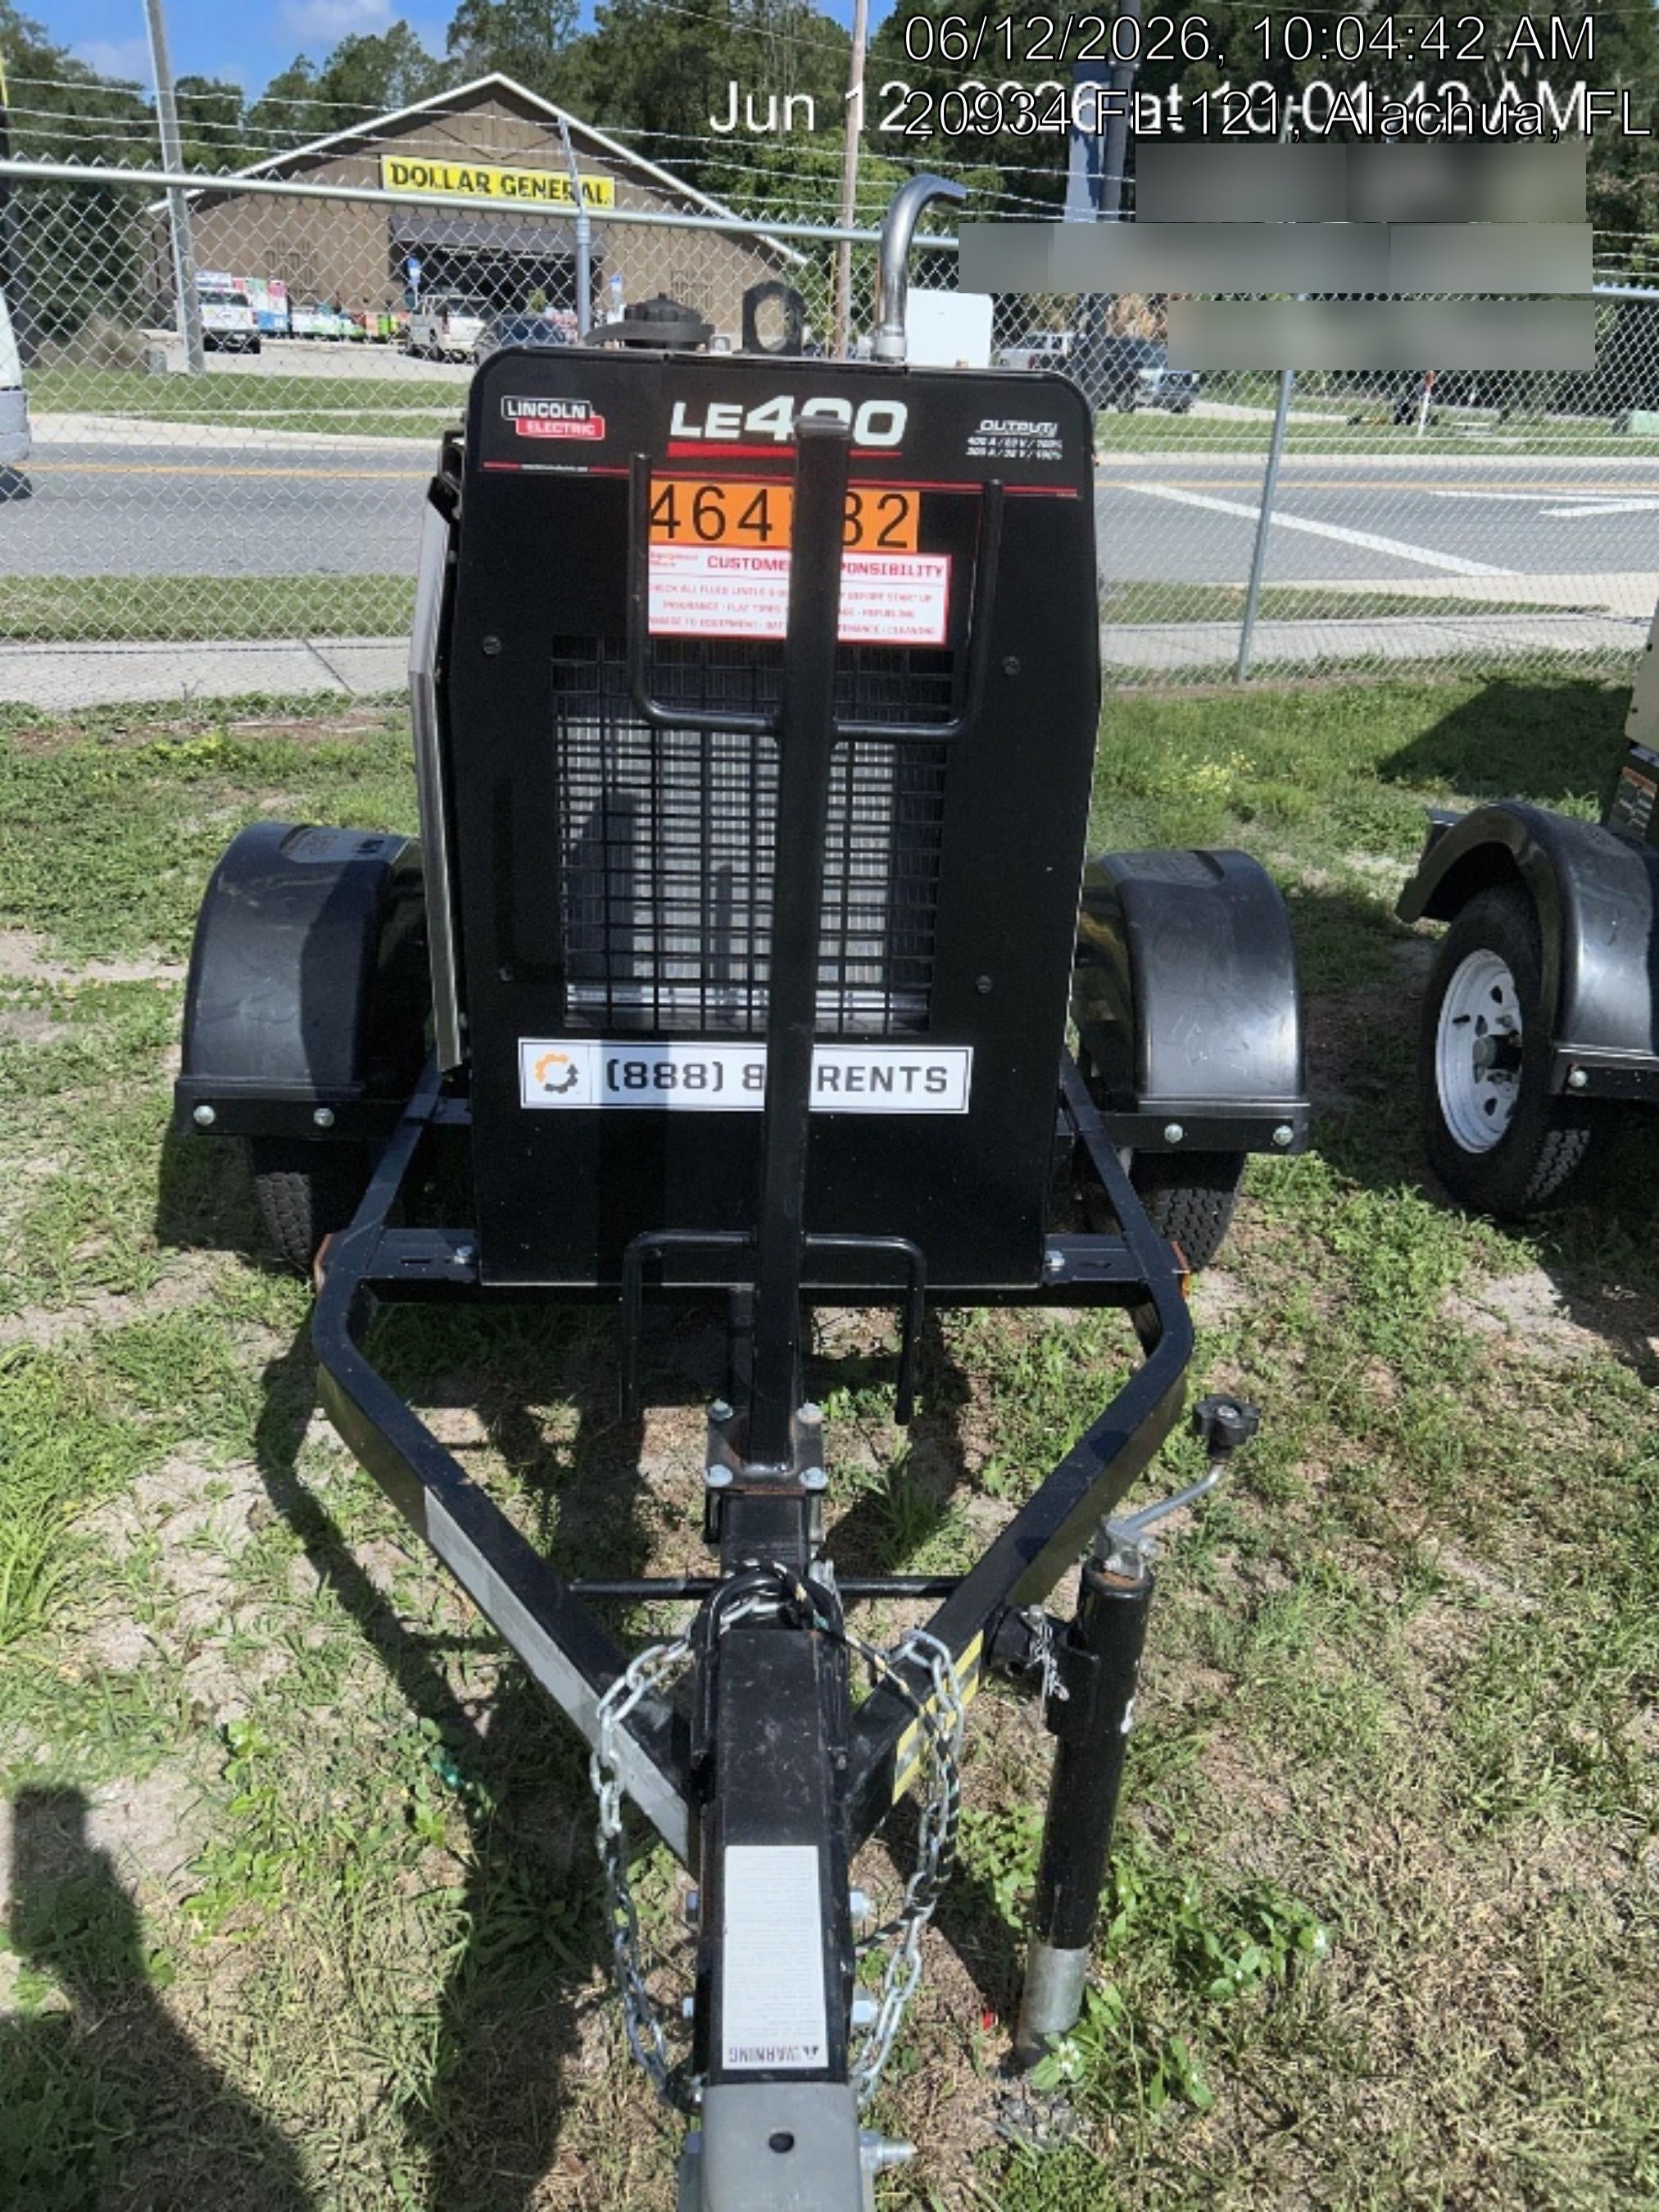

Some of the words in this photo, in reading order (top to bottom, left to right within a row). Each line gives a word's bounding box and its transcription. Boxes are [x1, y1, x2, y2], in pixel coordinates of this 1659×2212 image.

[390, 163, 492, 194] DOLLAR
[506, 399, 587, 420] LINCOLN
[527, 420, 596, 436] ELECTRIC
[980, 419, 1054, 434] OUTPUT
[707, 555, 789, 572] CUSTOME
[841, 561, 945, 578] ONSIBILITY
[606, 1058, 723, 1092] (888)
